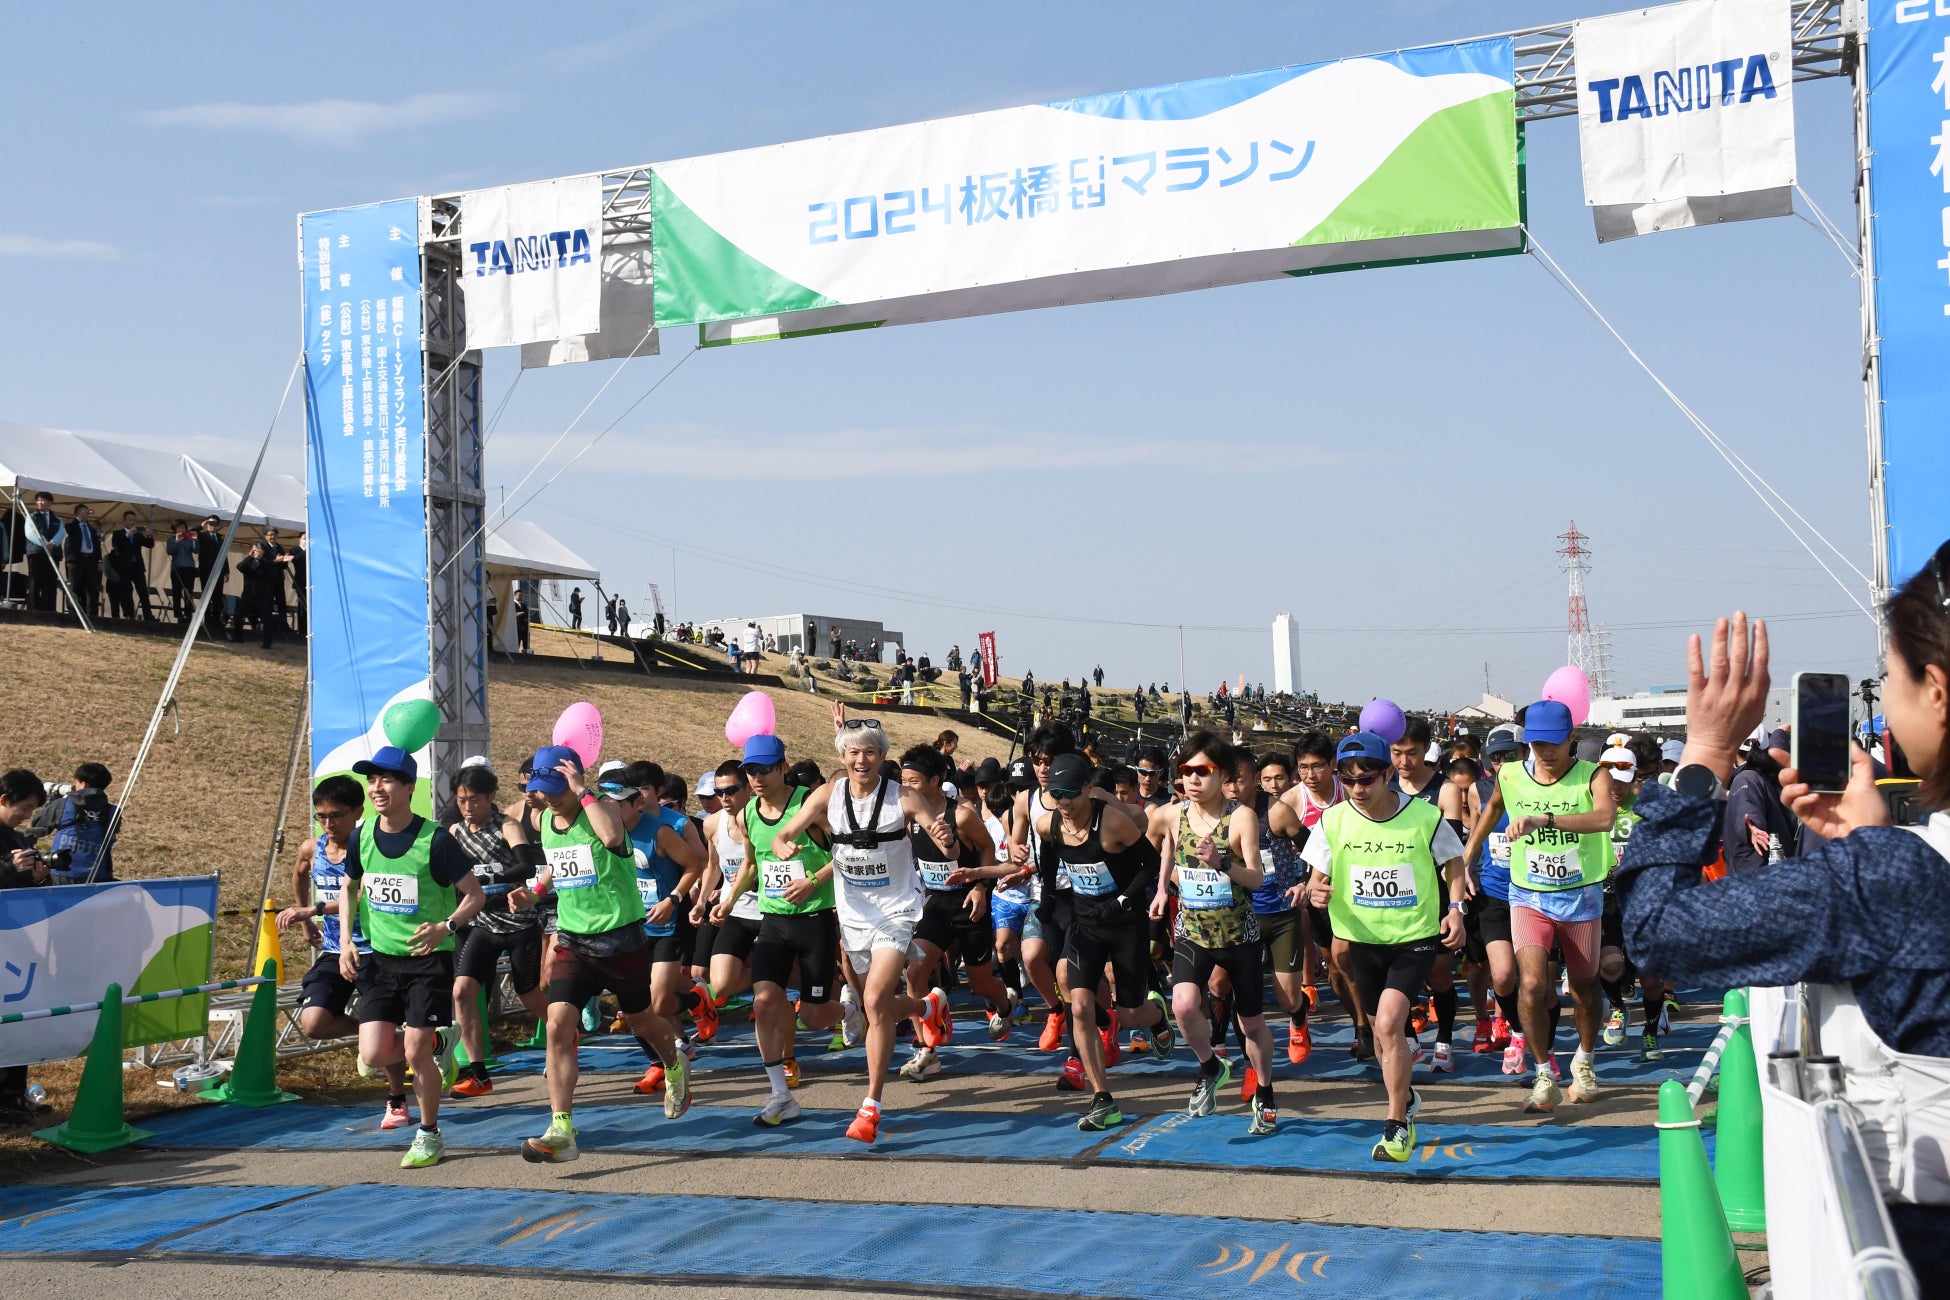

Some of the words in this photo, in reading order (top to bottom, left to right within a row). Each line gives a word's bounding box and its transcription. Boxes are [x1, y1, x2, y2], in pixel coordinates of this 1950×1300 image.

[1588, 54, 1778, 124] TANITA
[470, 228, 592, 277] TANITA
[1516, 801, 1579, 812] ペースメーカー
[1343, 841, 1415, 854] ペースメーカー
[553, 850, 578, 860] PACE
[1538, 854, 1566, 864] PACE
[769, 864, 791, 873] PACE
[1183, 869, 1219, 882] TANITA
[1364, 869, 1399, 880] PACE
[373, 877, 403, 887] PACE
[1079, 875, 1102, 886] 122
[1196, 884, 1214, 897] 54
